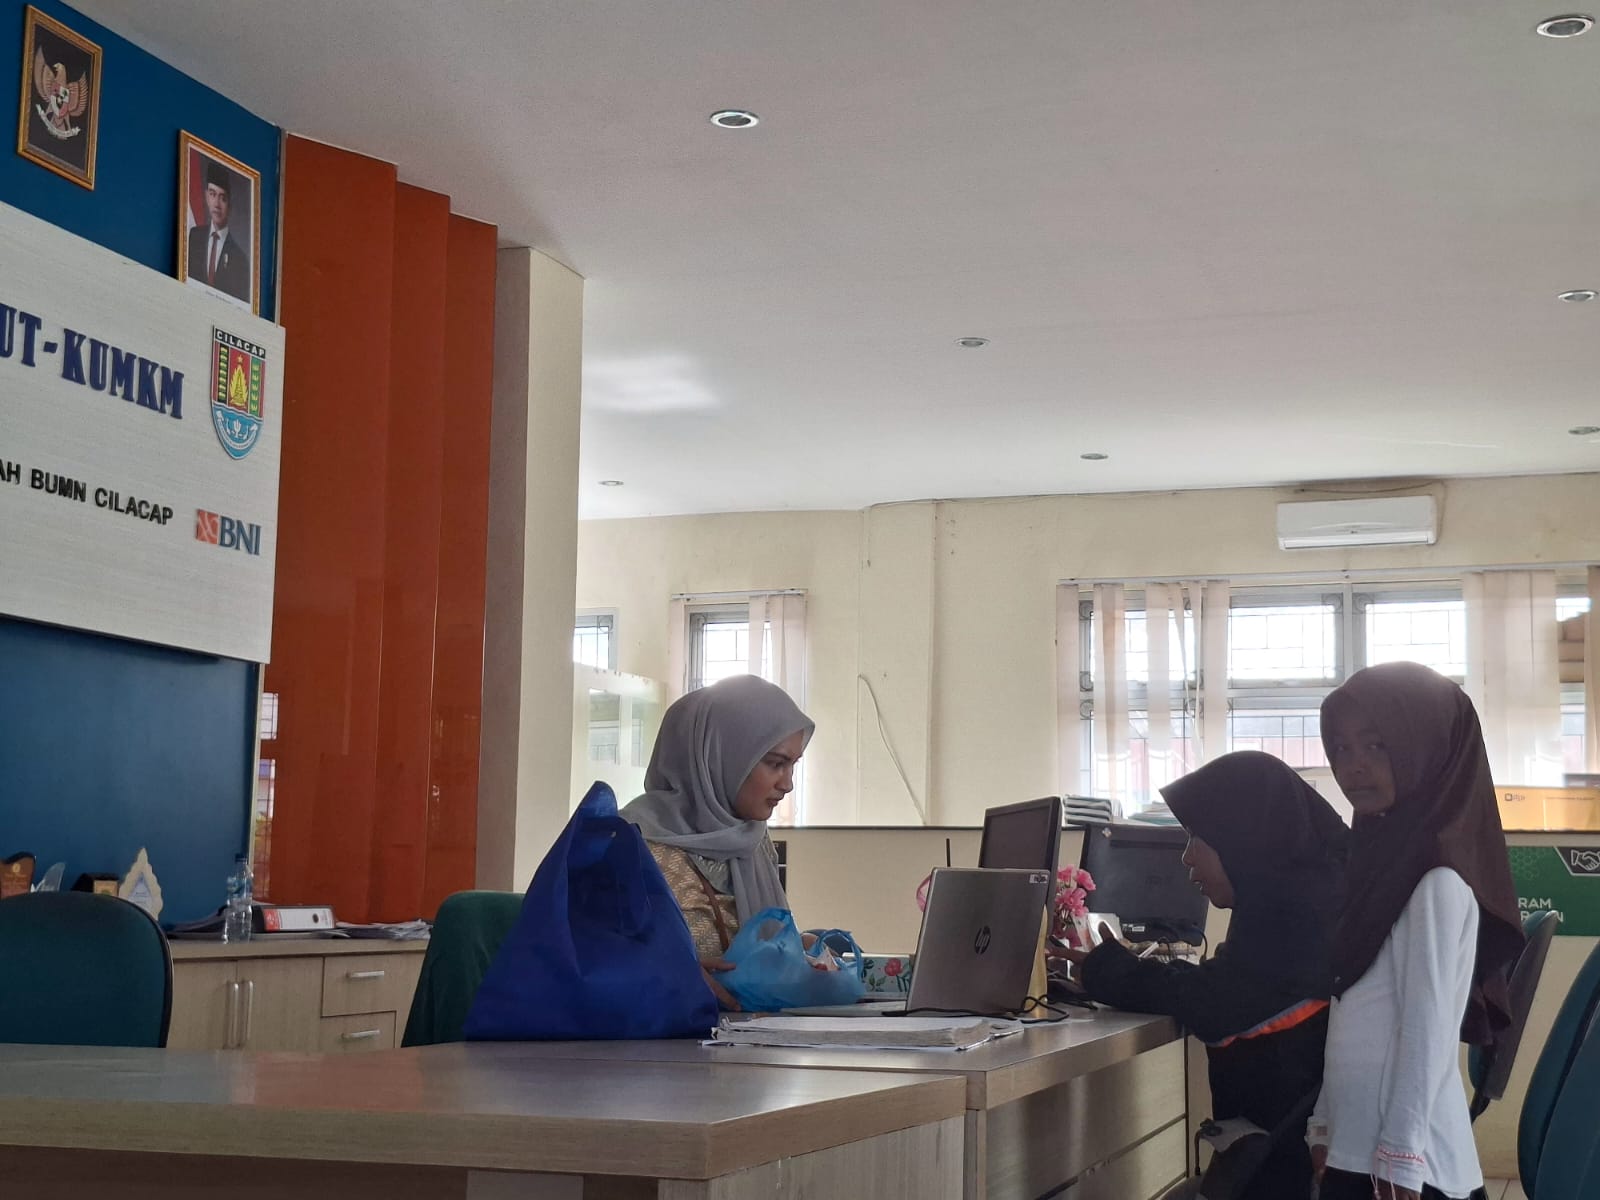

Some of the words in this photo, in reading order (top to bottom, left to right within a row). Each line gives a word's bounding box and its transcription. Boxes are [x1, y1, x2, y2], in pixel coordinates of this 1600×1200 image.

[215, 329, 265, 357] CILACAP
[30, 468, 87, 502] BUMN
[94, 487, 174, 525] CILACAP
[219, 515, 261, 556] BNI
